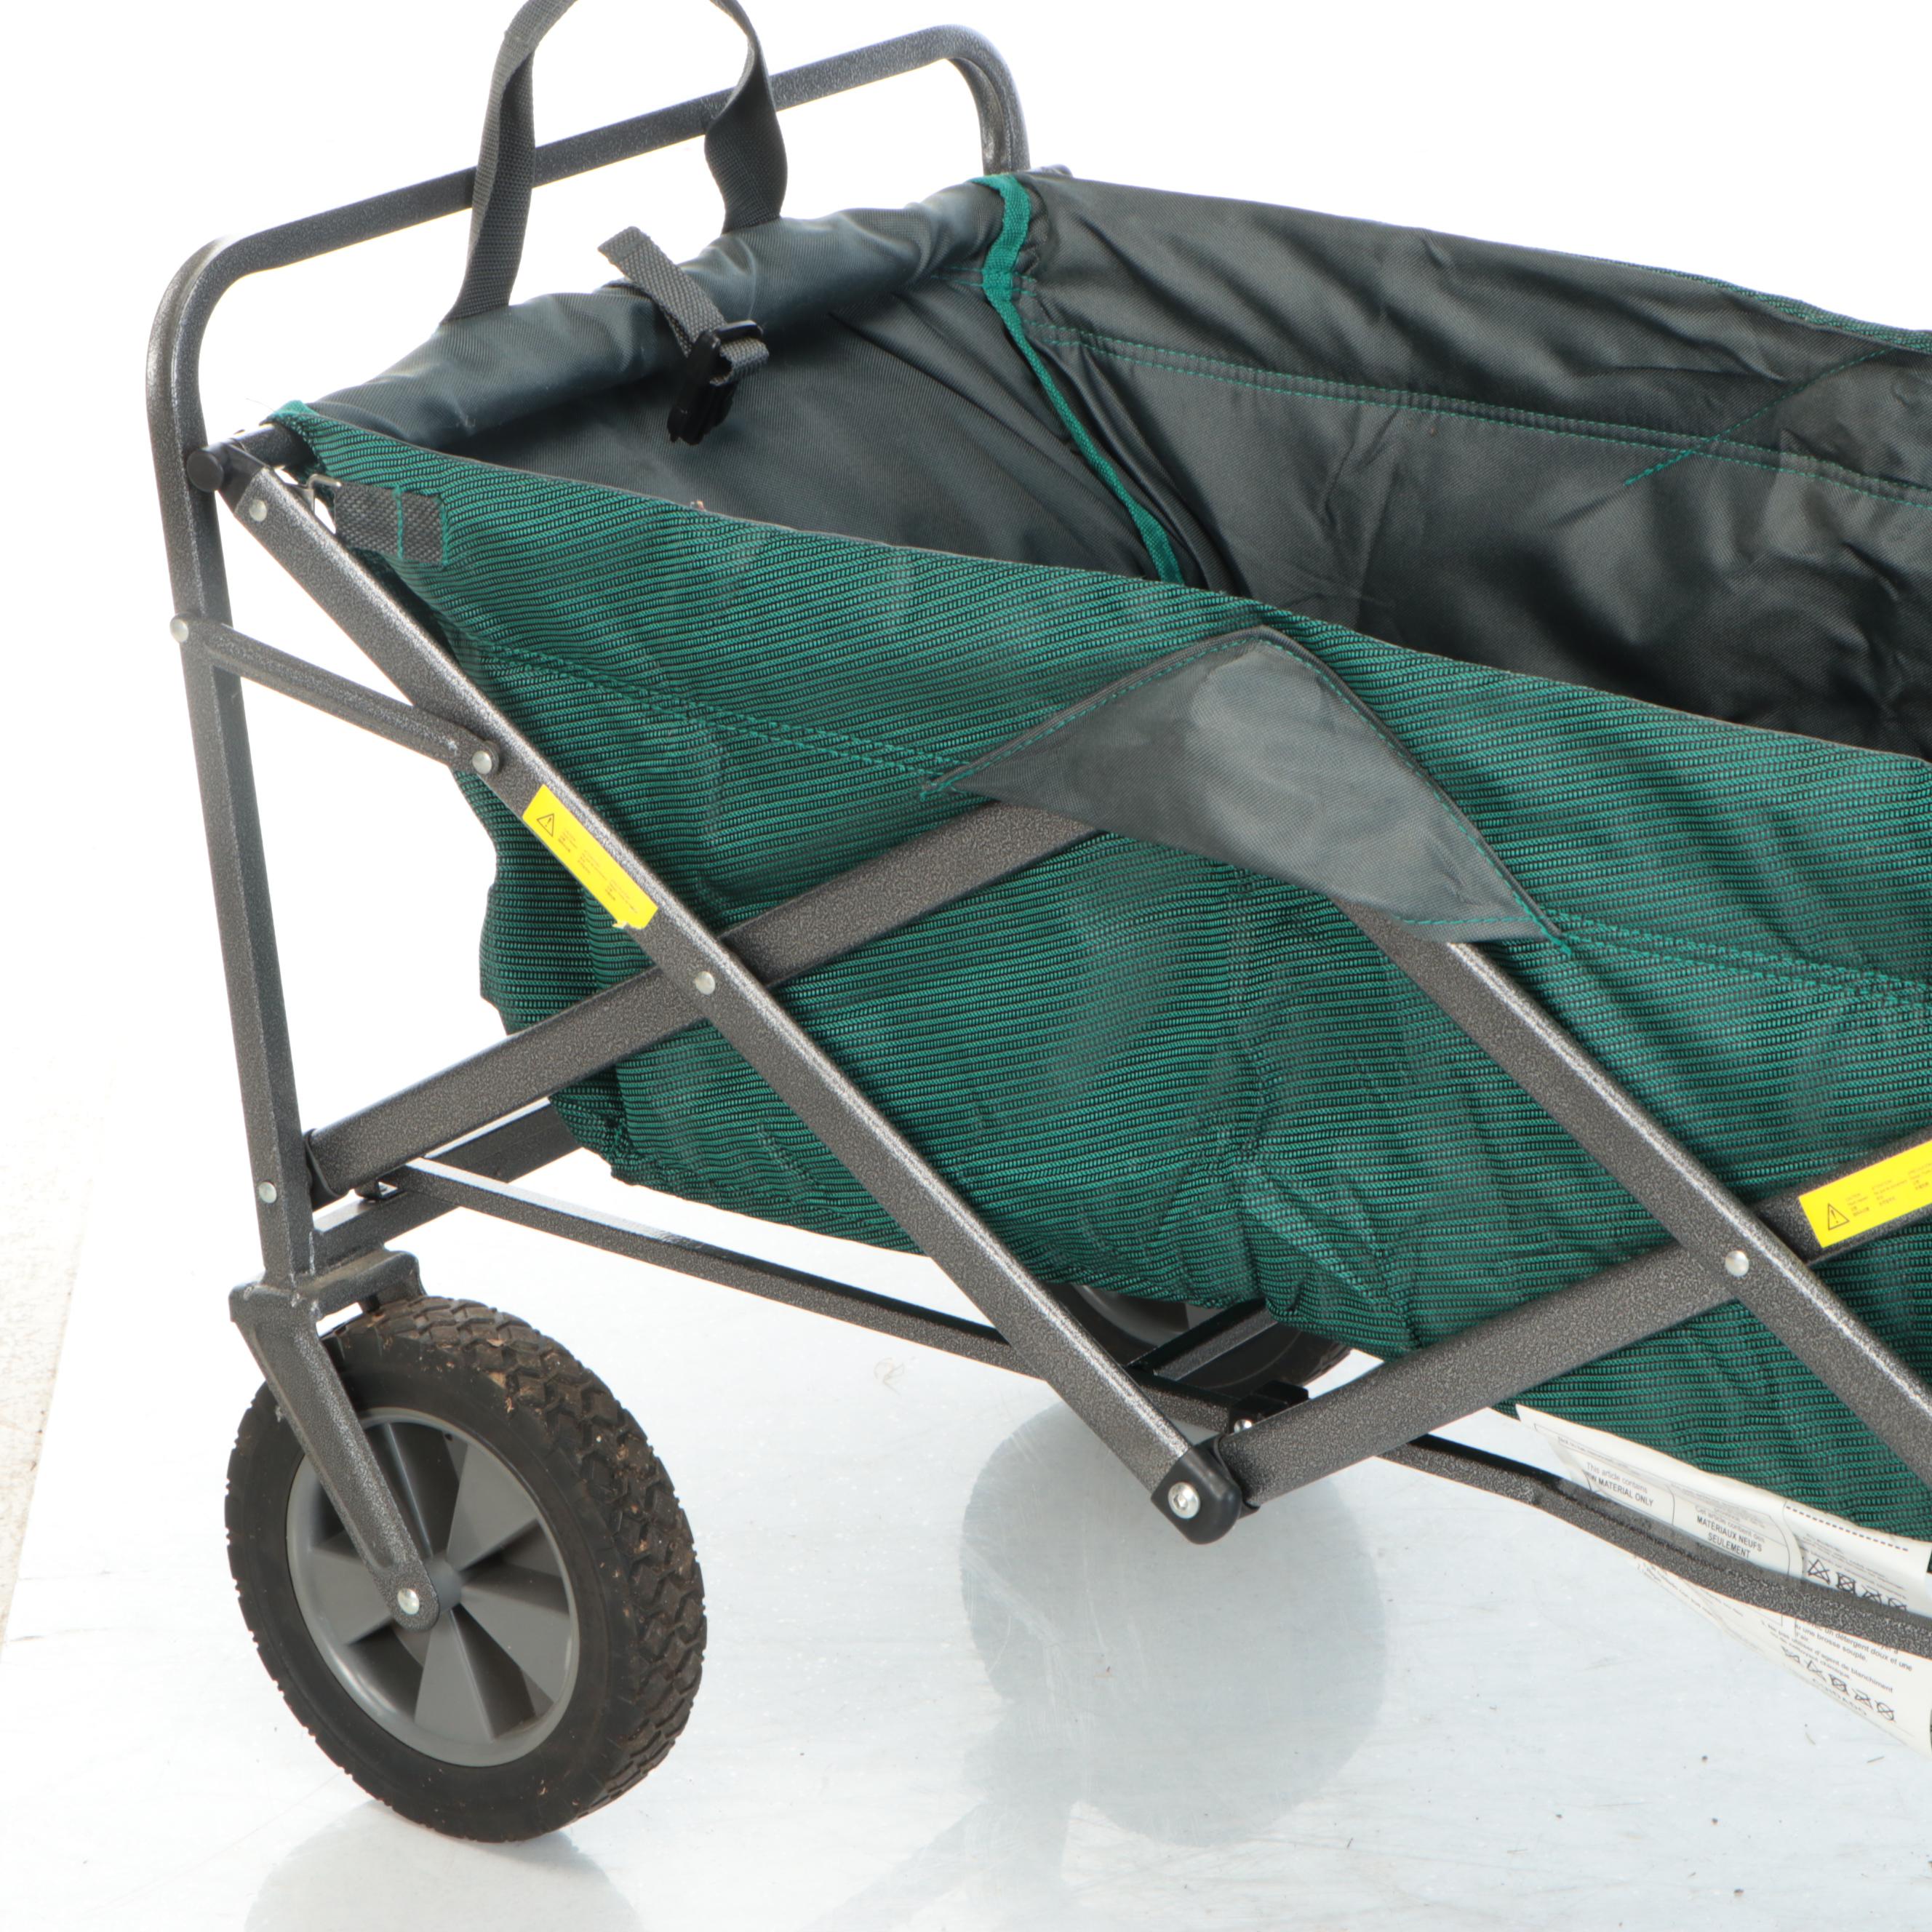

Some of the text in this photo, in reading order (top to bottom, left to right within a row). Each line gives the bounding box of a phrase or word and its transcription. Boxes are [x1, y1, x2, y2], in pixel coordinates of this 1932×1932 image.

[1586, 1461, 1600, 1474] This
[1602, 1469, 1621, 1481] article
[1621, 1477, 1648, 1494] contains
[1598, 1477, 1633, 1499] MATERIAL
[1634, 1493, 1654, 1507] ONLY
[1708, 1532, 1751, 1558] SEULEMENT
[1739, 1534, 1763, 1552] NEUFS
